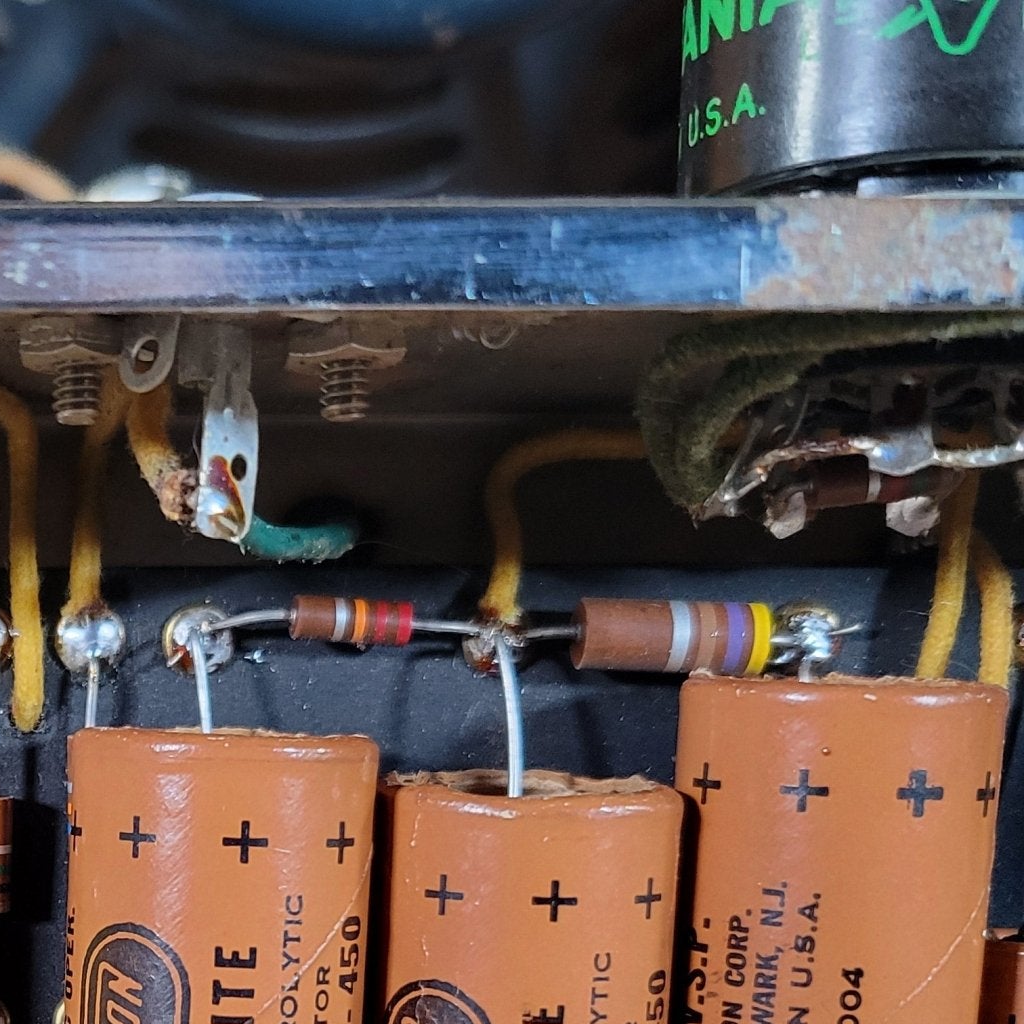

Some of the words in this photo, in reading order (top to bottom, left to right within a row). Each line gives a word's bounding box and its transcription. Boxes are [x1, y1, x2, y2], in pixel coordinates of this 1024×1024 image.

[688, 83, 766, 147] U.S.A.
[760, 881, 787, 927] N.J.
[725, 909, 752, 987] CORP.
[791, 893, 821, 988] U.S.A.
